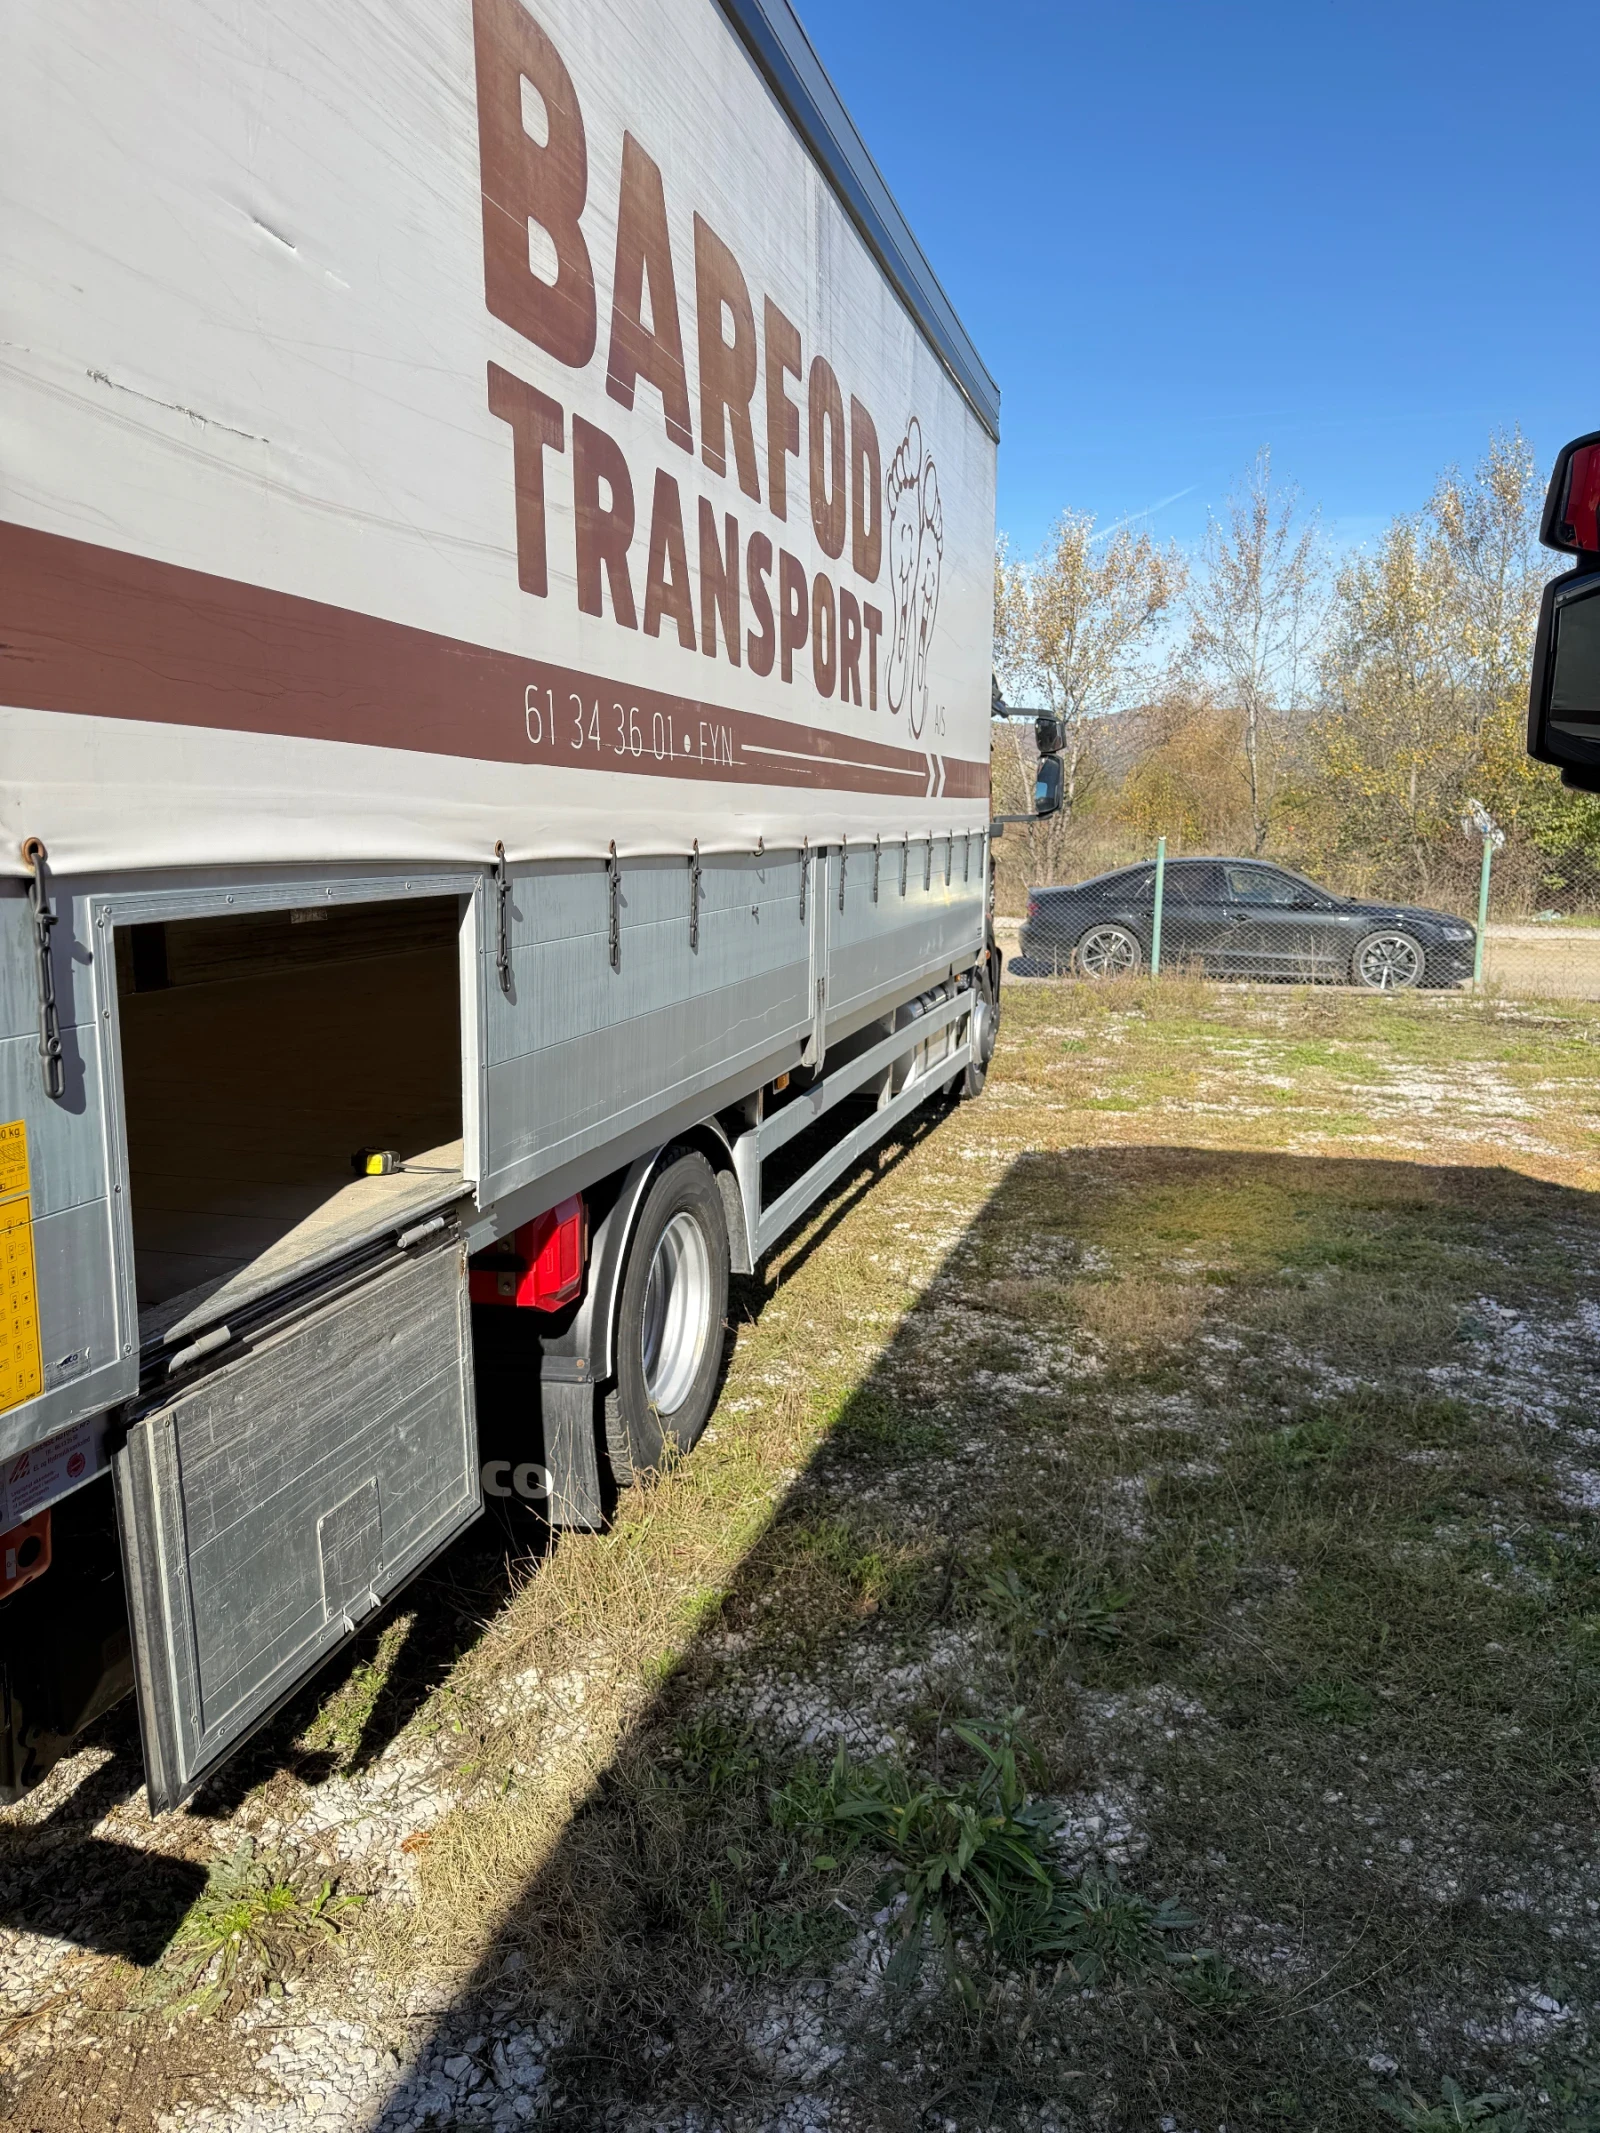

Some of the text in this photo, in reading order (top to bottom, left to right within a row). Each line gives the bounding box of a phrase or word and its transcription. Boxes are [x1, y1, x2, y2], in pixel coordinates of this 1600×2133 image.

[473, 0, 881, 583] BARFOD
[487, 360, 883, 712] TRANSPORT
[524, 684, 733, 767] 61 34 36 01 FYN
[9, 1127, 20, 1138] kg
